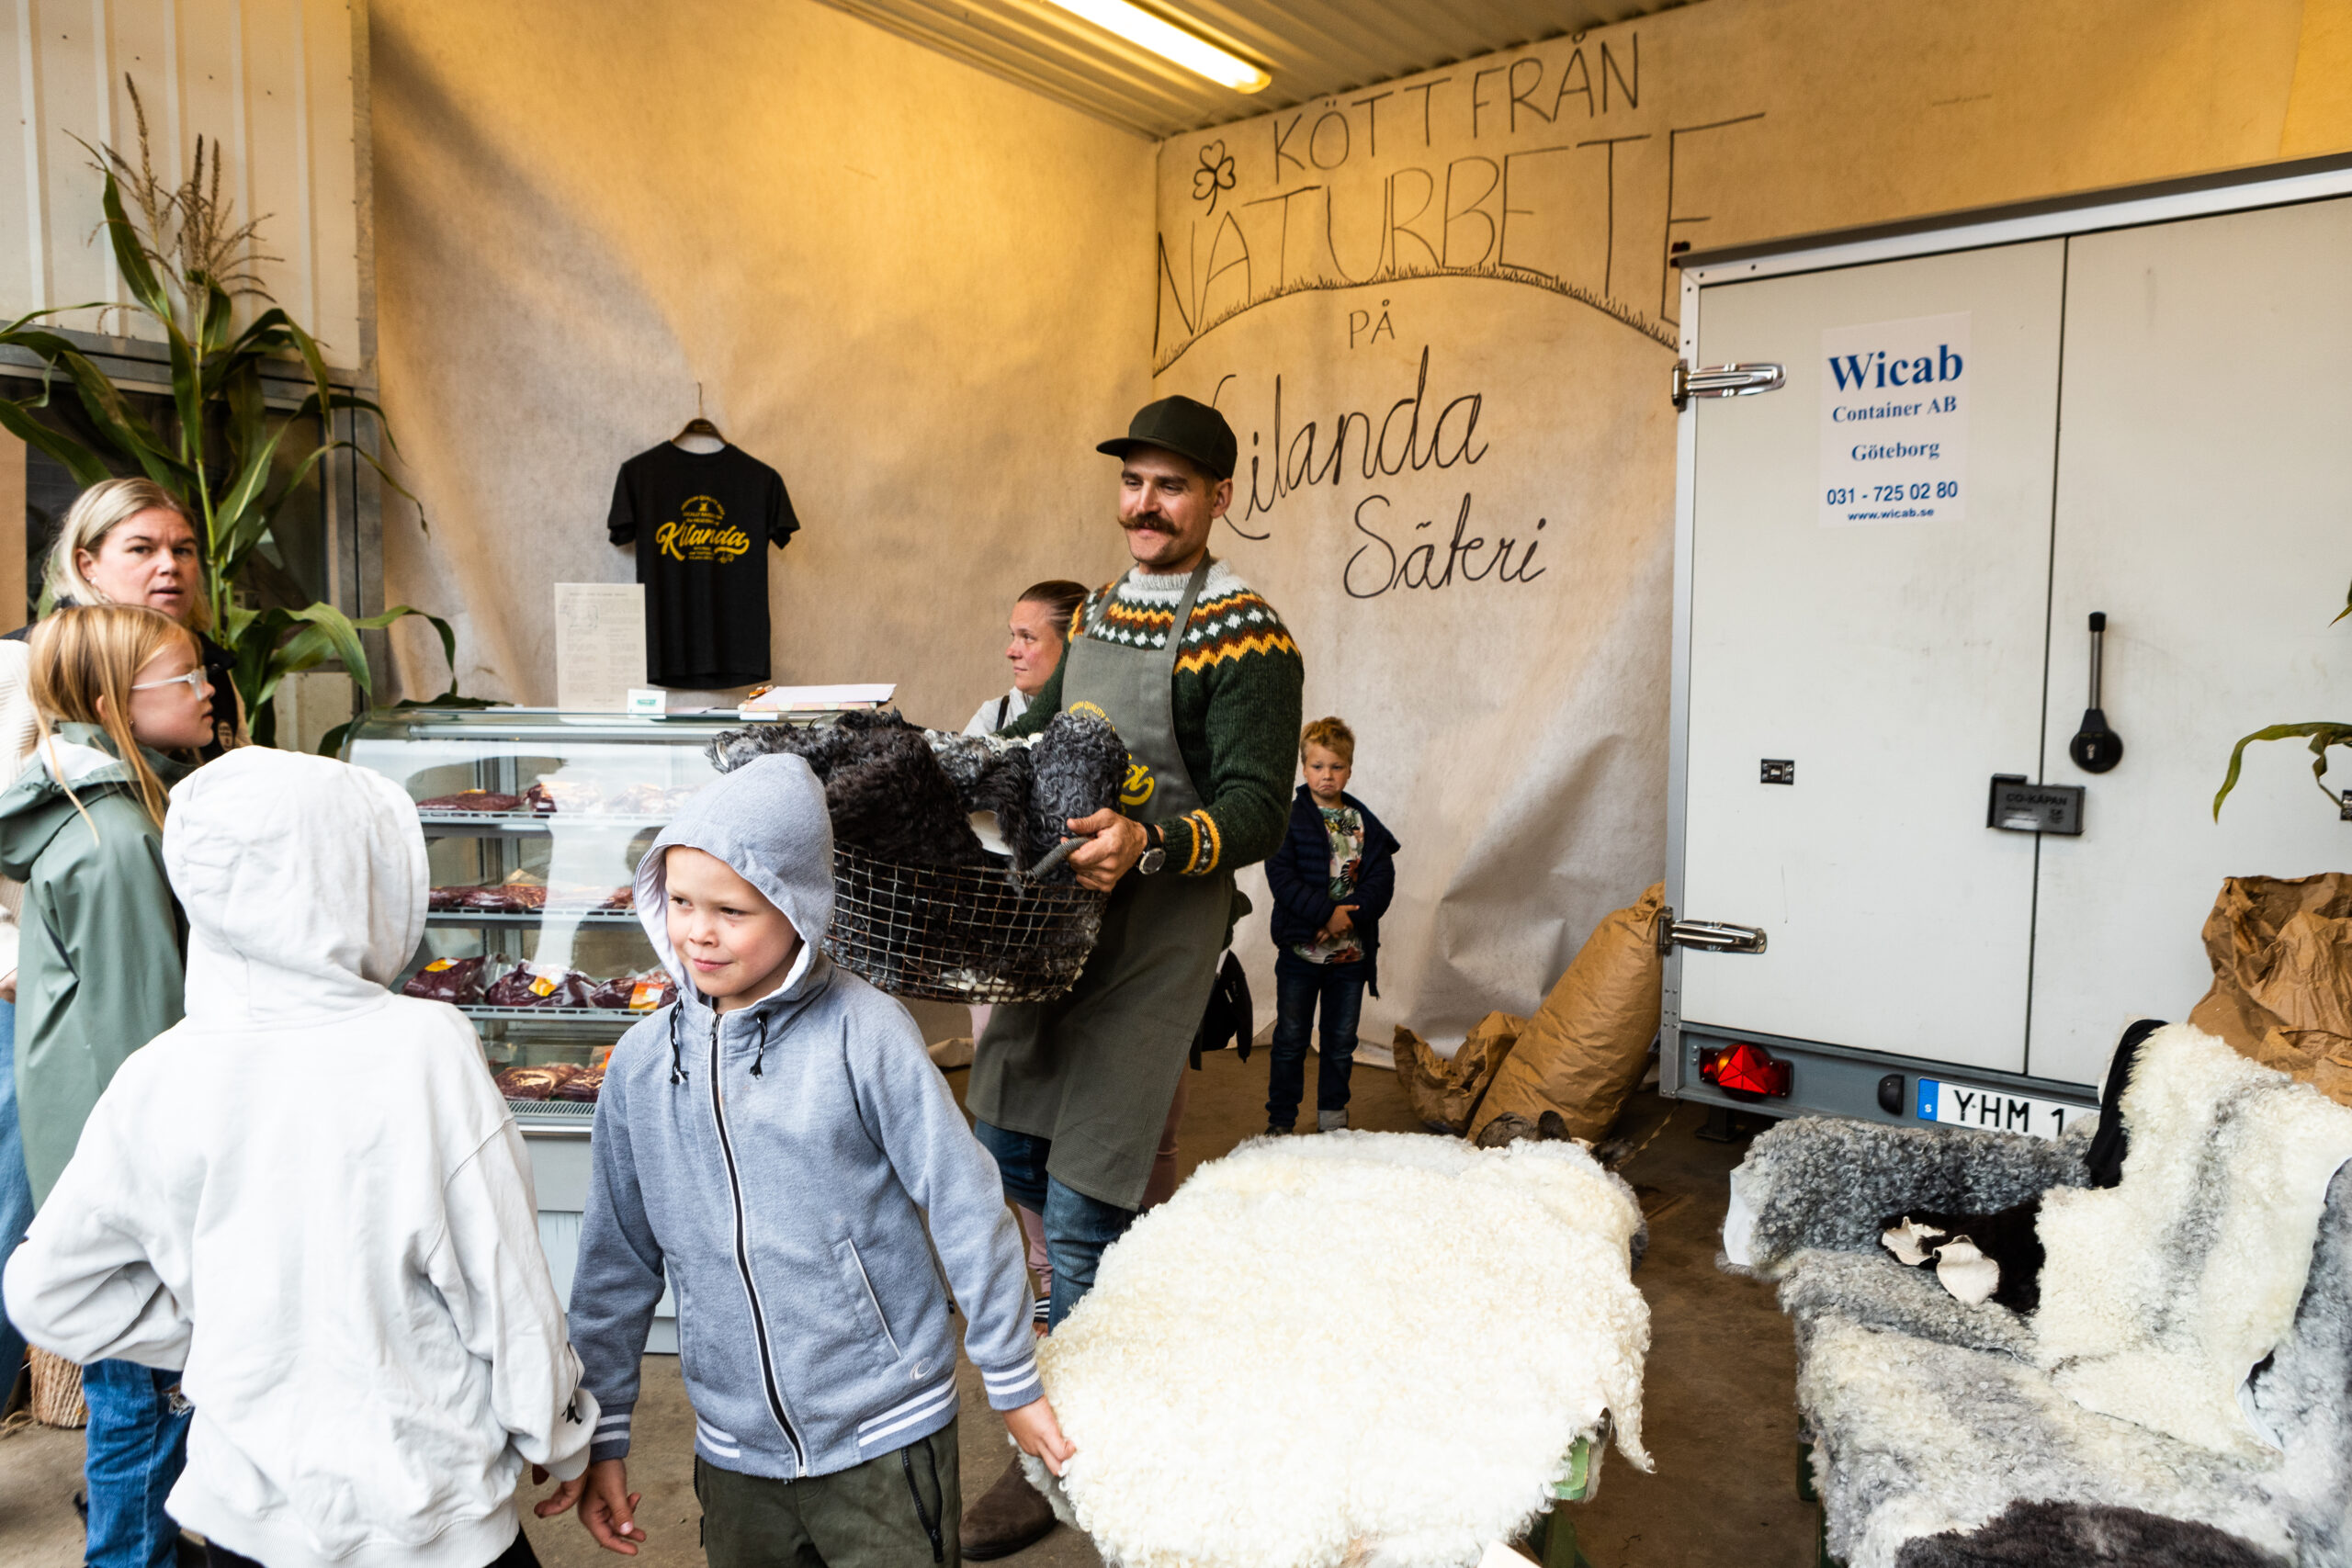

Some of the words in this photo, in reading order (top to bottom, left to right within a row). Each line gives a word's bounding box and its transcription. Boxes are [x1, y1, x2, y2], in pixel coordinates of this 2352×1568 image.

[1273, 77, 1452, 184] KÖTT
[1474, 32, 1639, 139] FRÅN
[1153, 112, 1766, 357] NATURBETE
[1349, 299, 1395, 349] PÅ
[1828, 344, 1963, 392] Wicab
[1833, 401, 1922, 423] Container
[1928, 396, 1957, 414] AB
[1851, 442, 1940, 461] Göteborg
[1826, 488, 1855, 505] 031
[1873, 485, 1904, 502] 725
[1909, 483, 1930, 500] 02
[1937, 480, 1958, 498] 80
[1848, 507, 1934, 521] www.wicab.se
[1925, 1104, 1932, 1113] S
[1954, 1090, 2030, 1133] YHM
